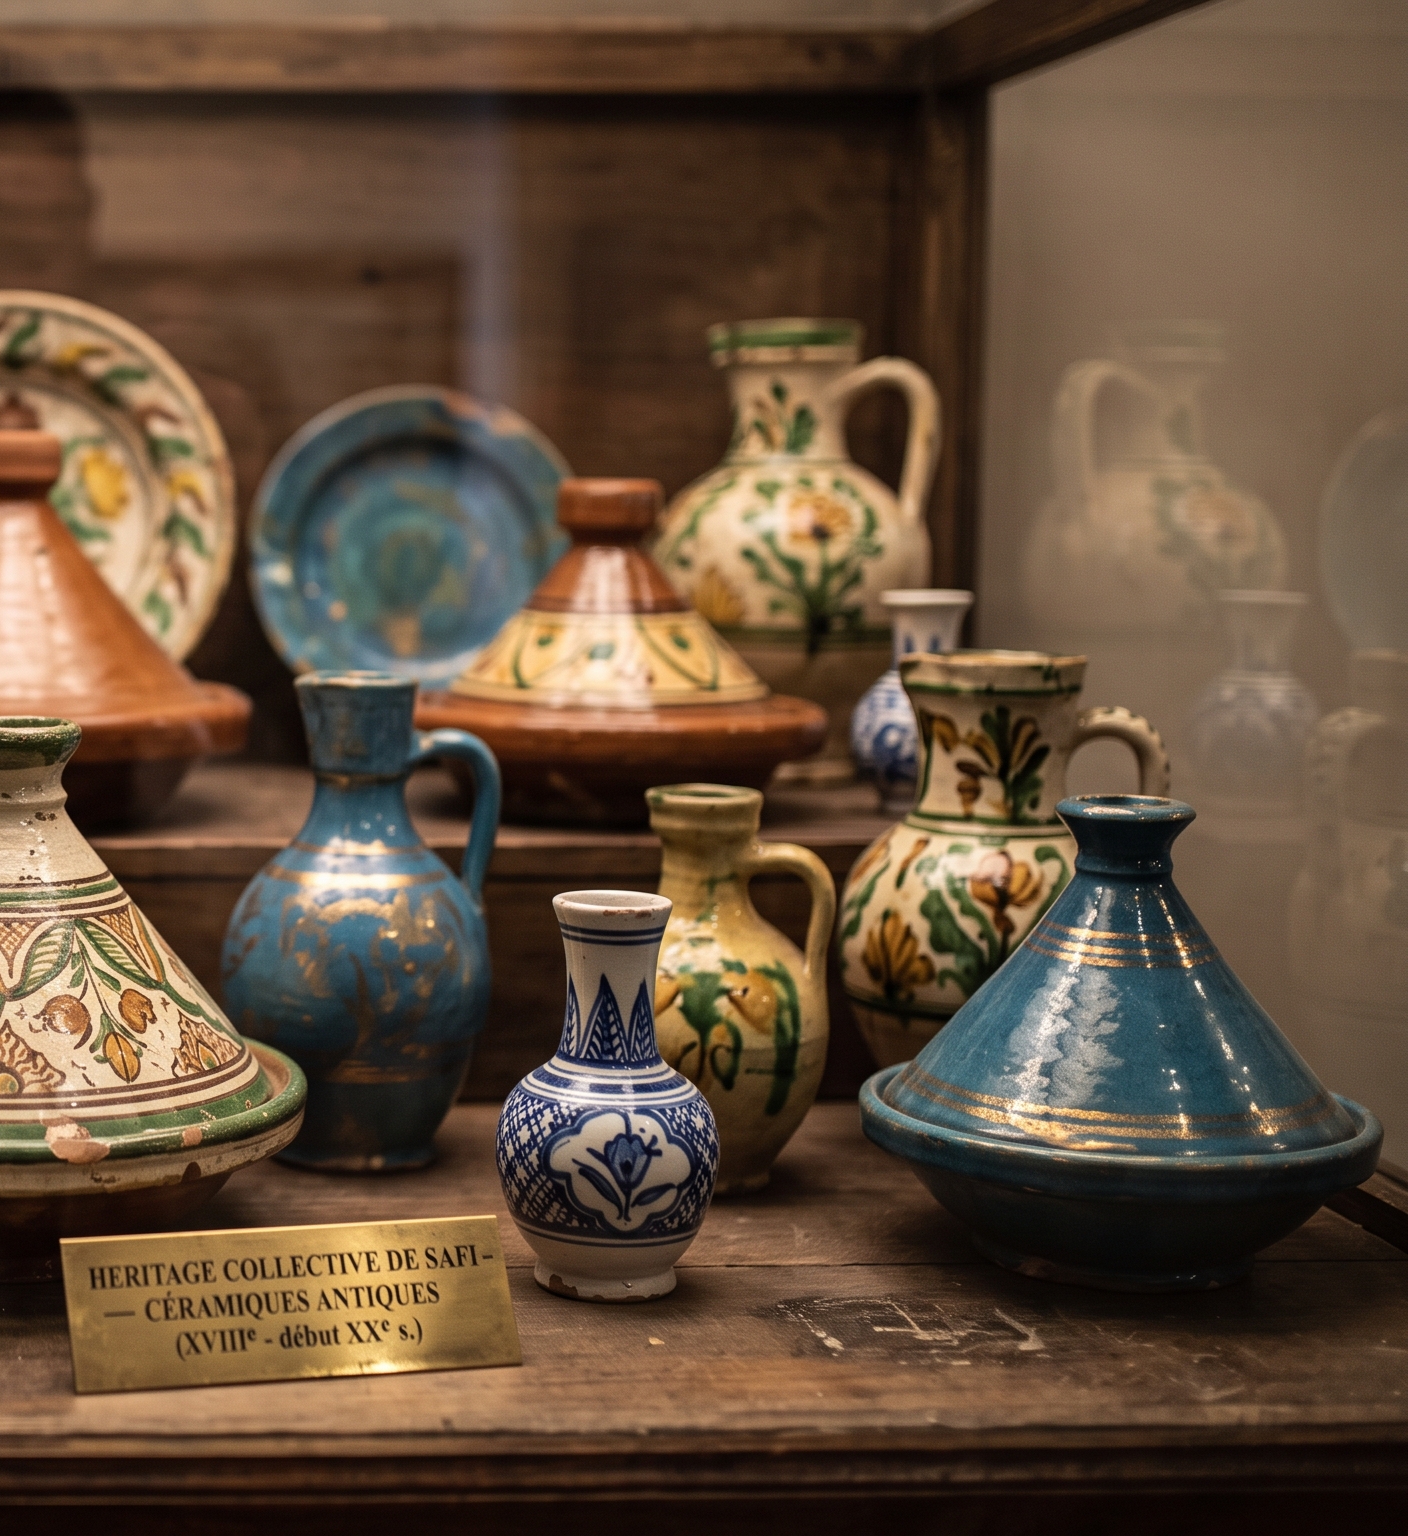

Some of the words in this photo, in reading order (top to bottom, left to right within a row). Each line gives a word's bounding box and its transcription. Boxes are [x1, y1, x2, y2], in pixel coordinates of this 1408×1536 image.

[88, 1259, 216, 1290] HERITAGE
[223, 1252, 380, 1283] COLLECTIVE
[386, 1249, 420, 1272] DE
[425, 1245, 478, 1269] SAFI
[145, 1290, 310, 1322] CÉRAMIQUES
[317, 1281, 440, 1313] ANTIQUES
[279, 1325, 340, 1350] début
[398, 1317, 423, 1345] s.)
